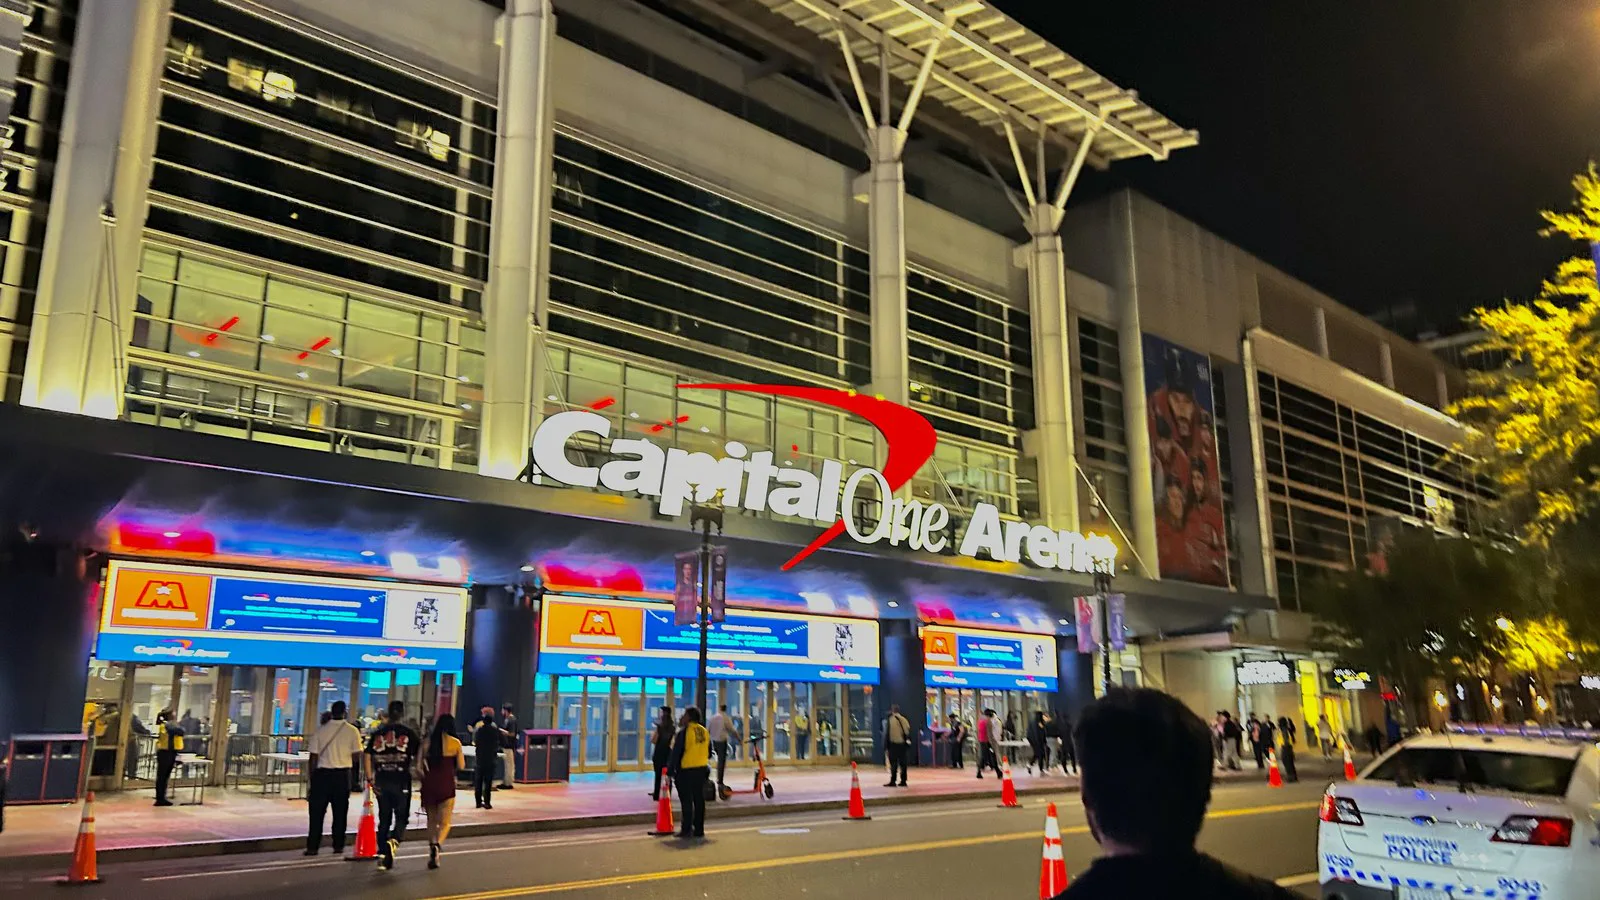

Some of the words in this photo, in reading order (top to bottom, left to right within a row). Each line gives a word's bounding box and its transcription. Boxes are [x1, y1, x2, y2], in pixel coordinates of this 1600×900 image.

[531, 411, 843, 522] Capital
[842, 468, 950, 554] One
[1387, 844, 1454, 867] POLICE
